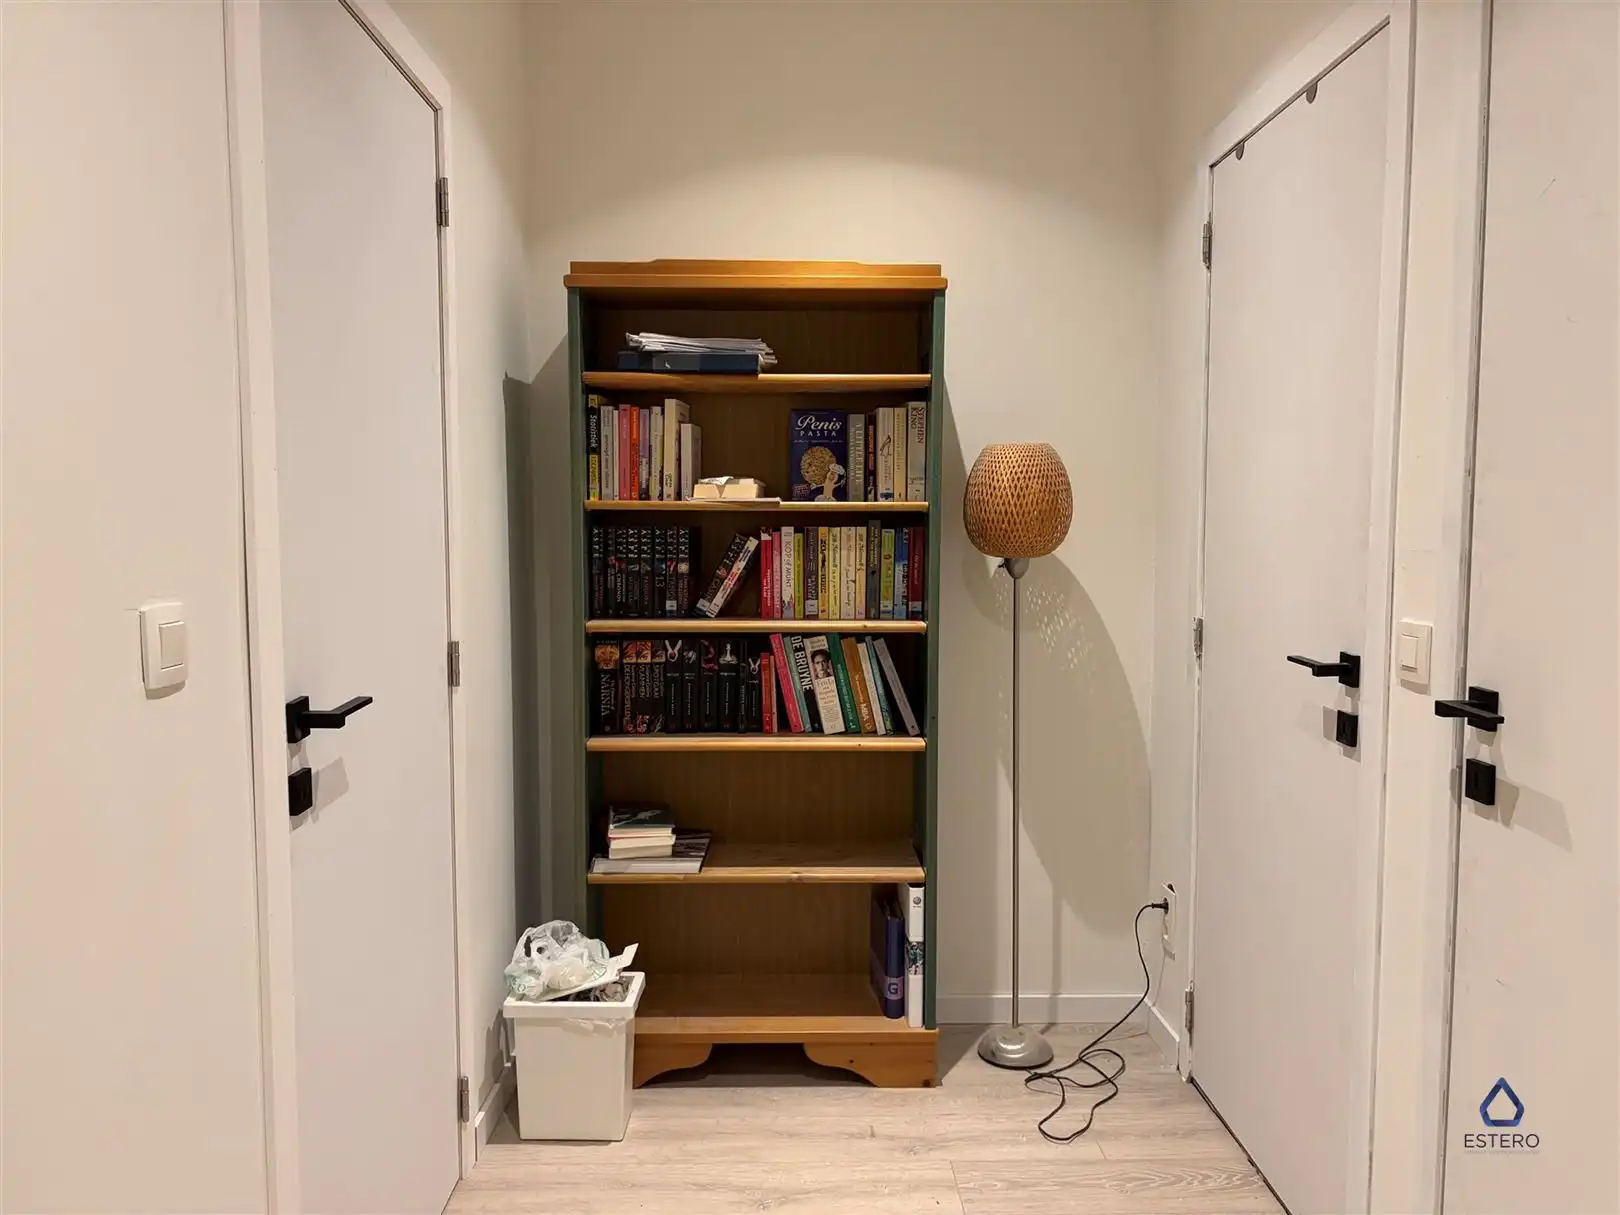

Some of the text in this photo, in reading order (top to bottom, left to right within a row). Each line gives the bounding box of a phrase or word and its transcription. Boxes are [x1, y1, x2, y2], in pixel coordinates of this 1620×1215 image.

[795, 415, 842, 431] Penis
[910, 407, 918, 429] KING
[589, 414, 599, 449] Statistiek
[655, 576, 665, 588] 13
[790, 635, 814, 692] DE BRUYNE
[600, 673, 610, 716] NARNIA
[887, 982, 899, 995] G
